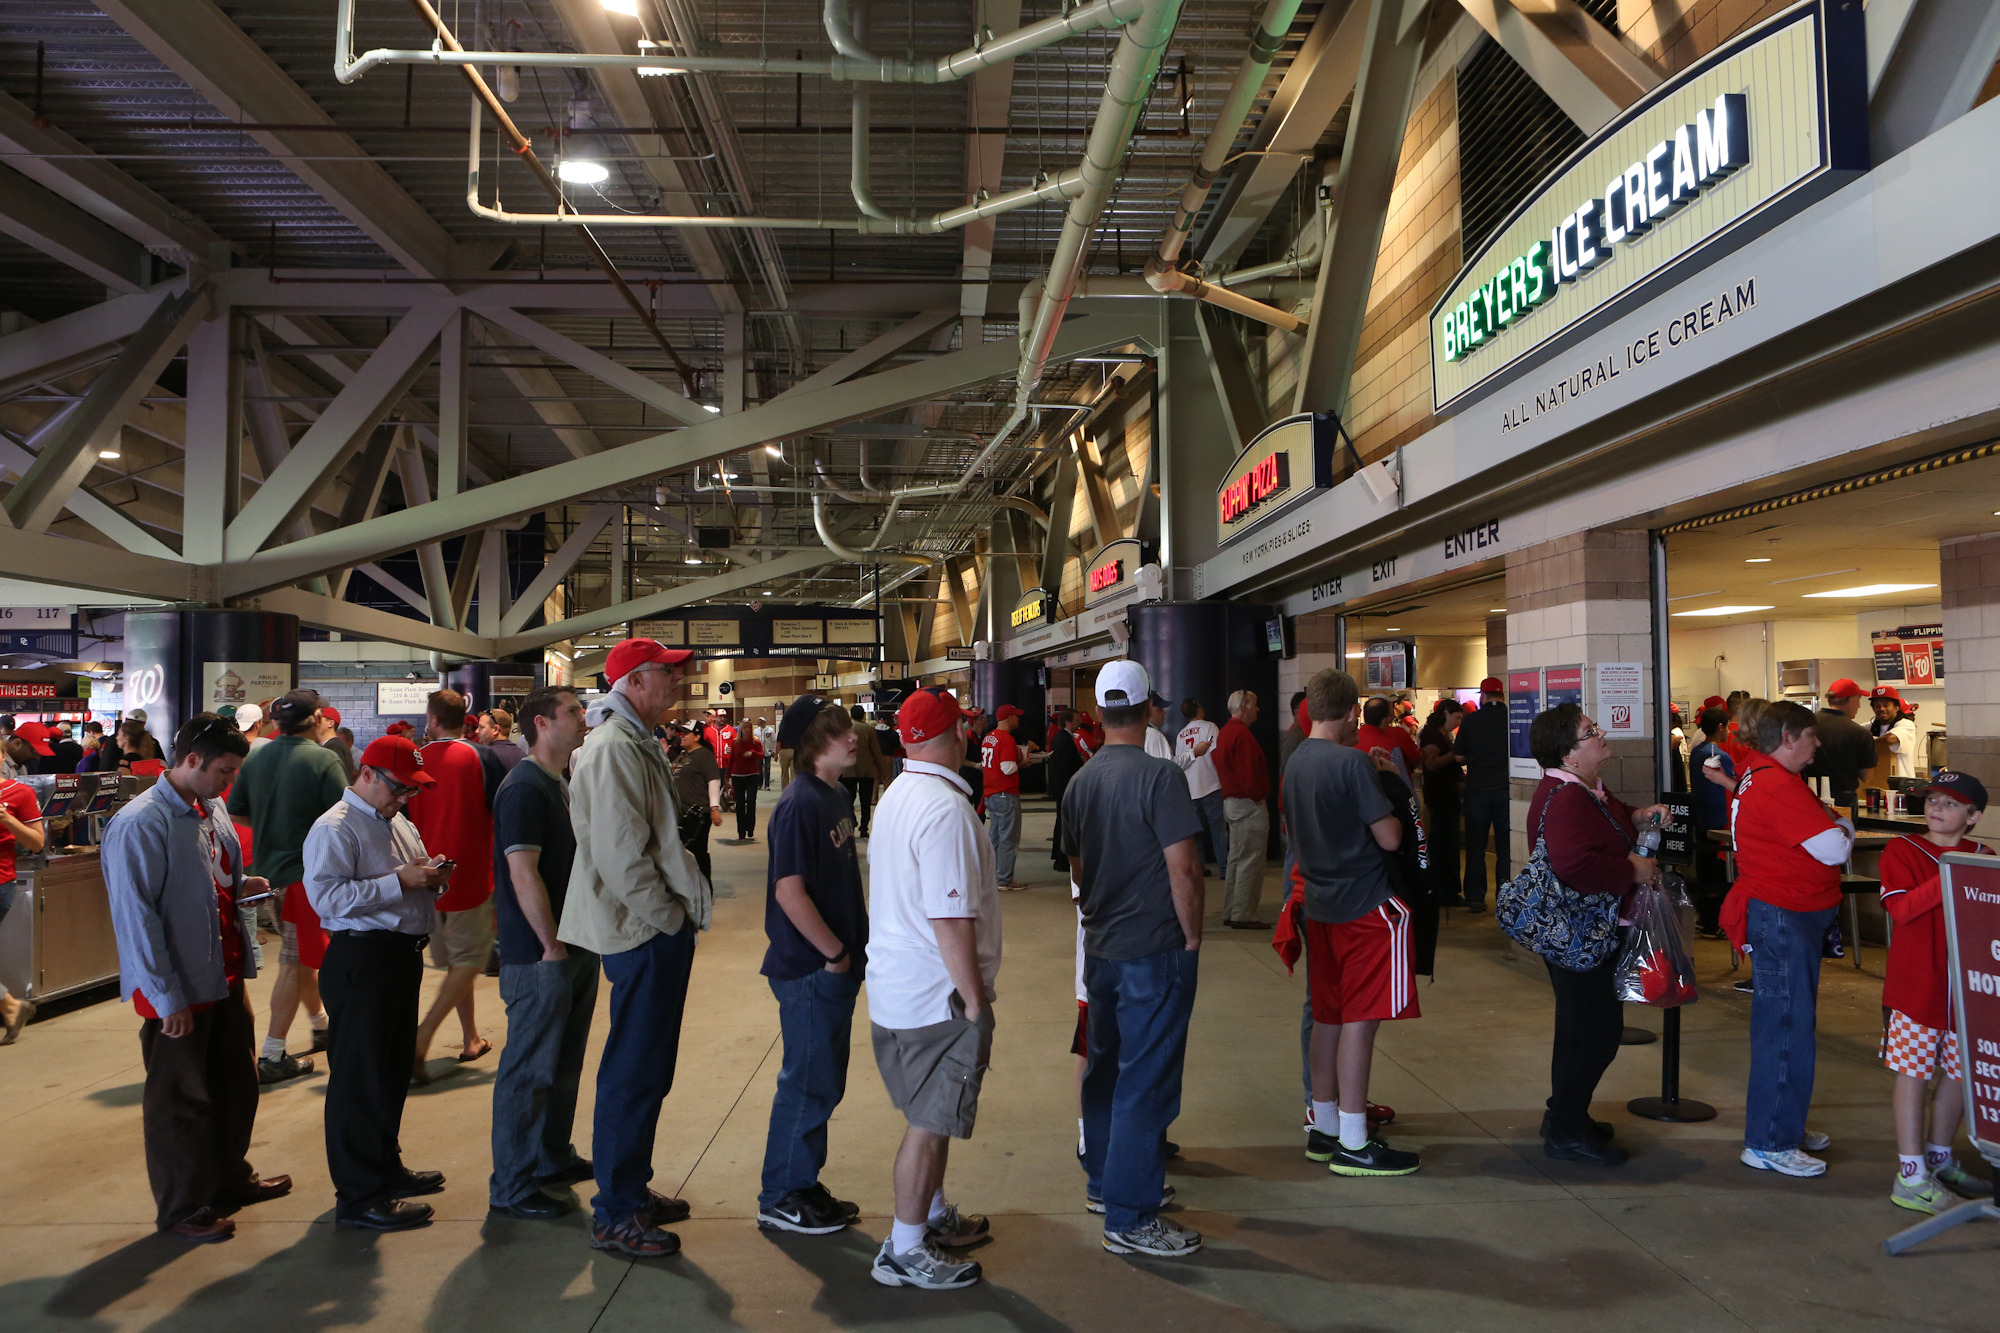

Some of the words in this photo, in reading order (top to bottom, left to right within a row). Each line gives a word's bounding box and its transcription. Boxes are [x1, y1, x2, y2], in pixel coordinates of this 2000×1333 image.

[1443, 240, 1543, 362] BREYERS
[1552, 198, 1596, 285] ICE
[1605, 93, 1729, 244] CREAM
[1501, 403, 1531, 434] ALL
[1535, 355, 1620, 416] NATURAL
[1626, 330, 1661, 369] ICE
[1668, 278, 1756, 346] CREAM
[1252, 452, 1279, 502] PIZZA
[1242, 551, 1253, 564] NEW
[1253, 544, 1268, 559] YORK
[1269, 535, 1282, 550] PIES
[1288, 519, 1311, 543] SLICES
[1444, 518, 1500, 560] ENTER
[1103, 559, 1118, 587] DOGS
[1372, 555, 1398, 582] EXIT
[1312, 576, 1342, 602] ENTER
[37, 608, 59, 619] 117
[0, 684, 28, 696] TIMES
[32, 685, 55, 696] CAFE
[981, 747, 994, 769] 37
[52, 792, 76, 800] RELISH
[96, 788, 119, 796] ONIONS
[1663, 804, 1689, 816] EASE
[1666, 840, 1685, 851] HERE
[1977, 1038, 2000, 1058] SOL
[1980, 1104, 2000, 1123] 13
